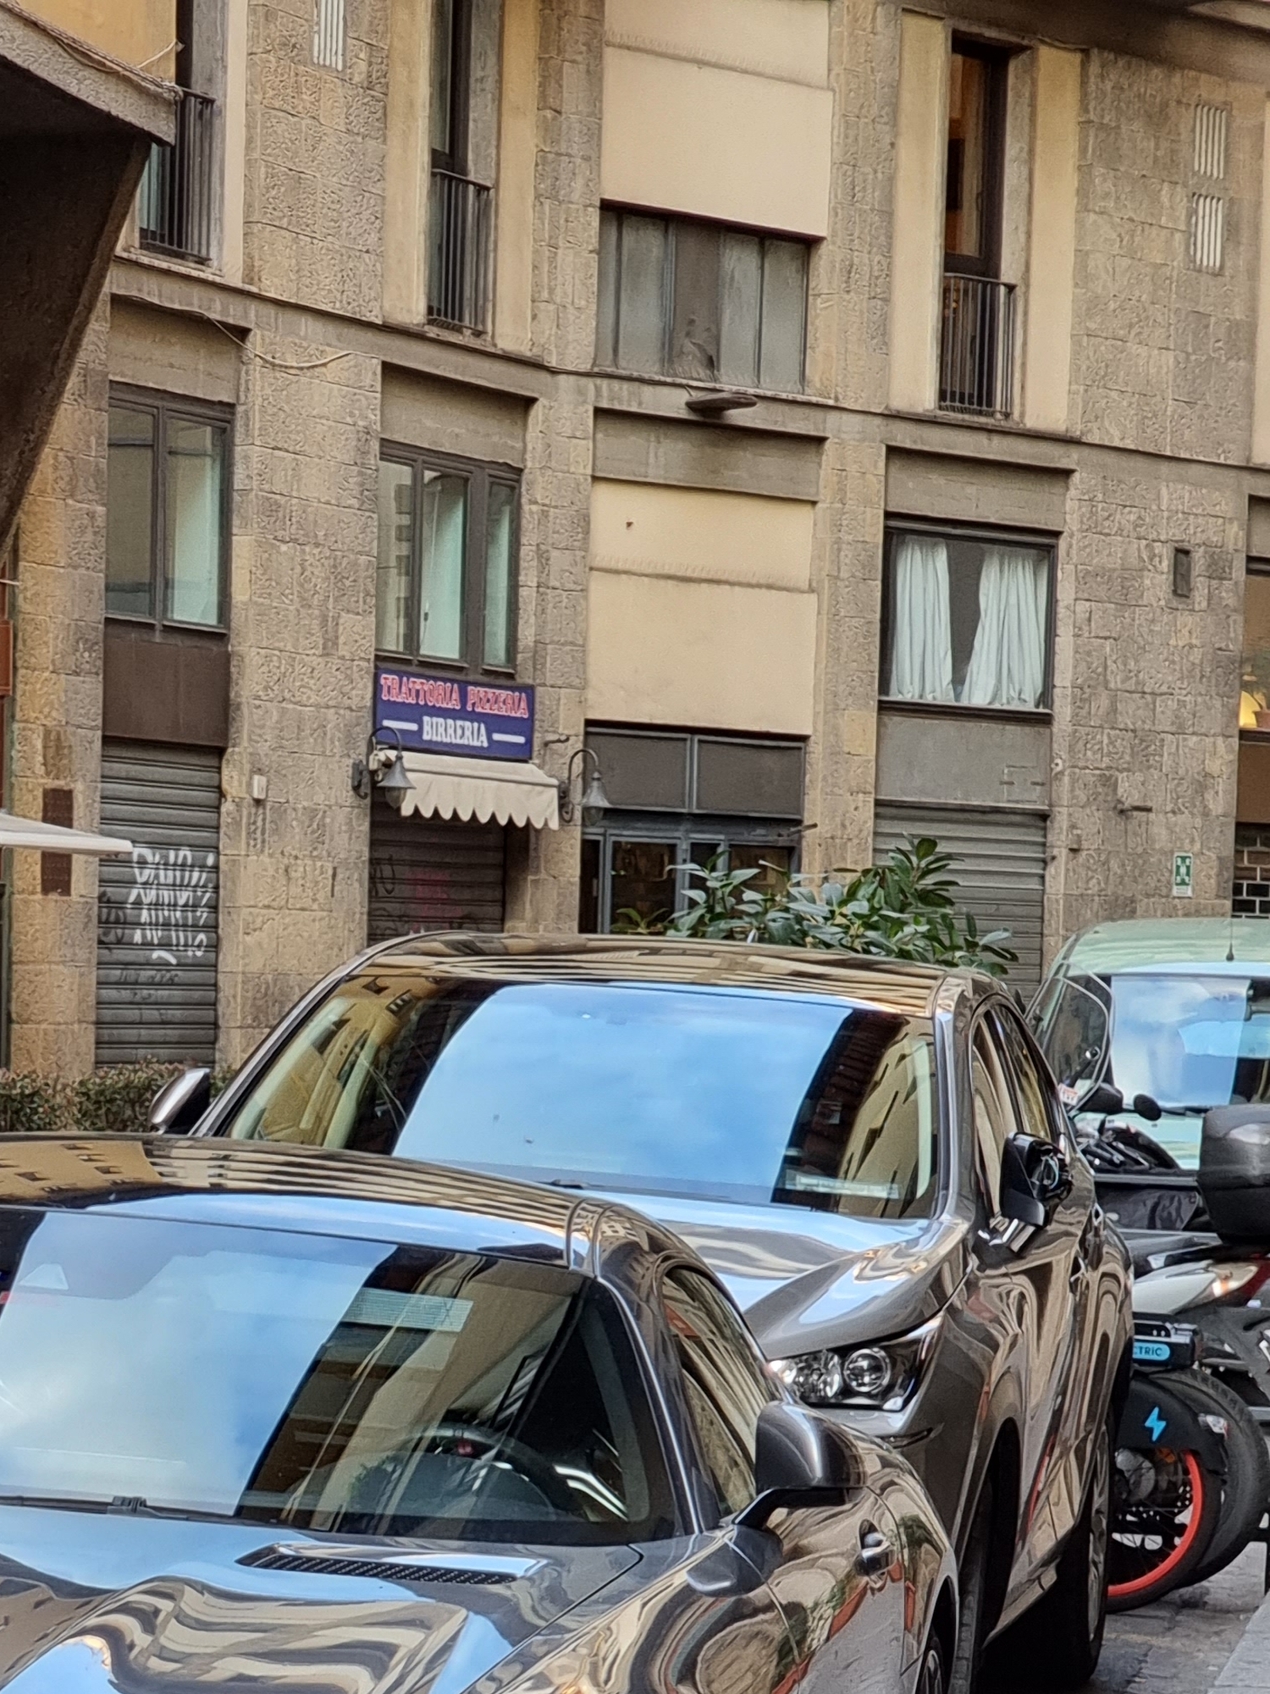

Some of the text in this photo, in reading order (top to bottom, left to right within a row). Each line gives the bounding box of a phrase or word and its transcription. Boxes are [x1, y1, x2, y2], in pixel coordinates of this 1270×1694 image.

[380, 674, 529, 718] TRATTORIA PIZZERIA
[422, 715, 489, 748] BIRRERIA
